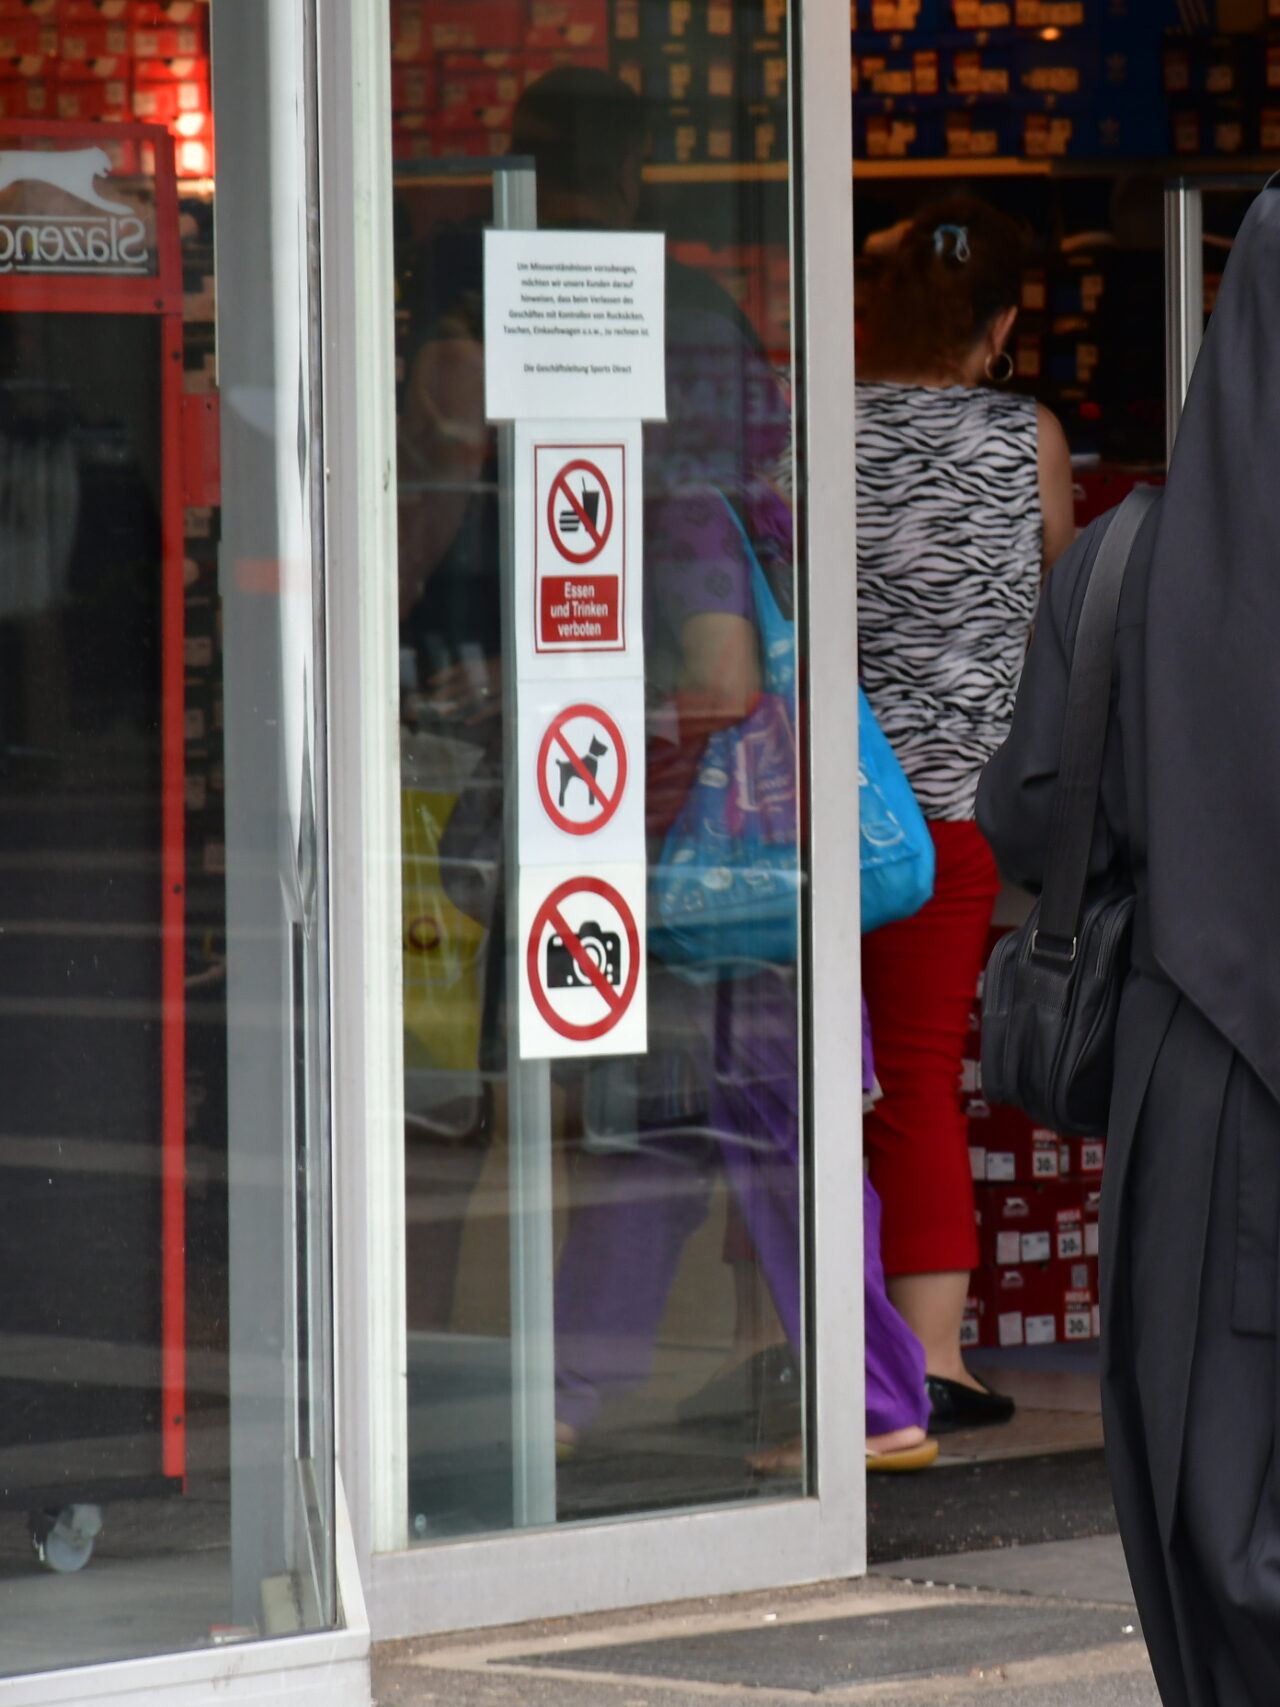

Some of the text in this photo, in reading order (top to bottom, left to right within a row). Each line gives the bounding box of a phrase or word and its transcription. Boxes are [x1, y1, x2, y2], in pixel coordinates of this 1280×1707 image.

[564, 581, 595, 598] Essen
[550, 601, 609, 618] und Trinken
[558, 620, 601, 637] verboten
